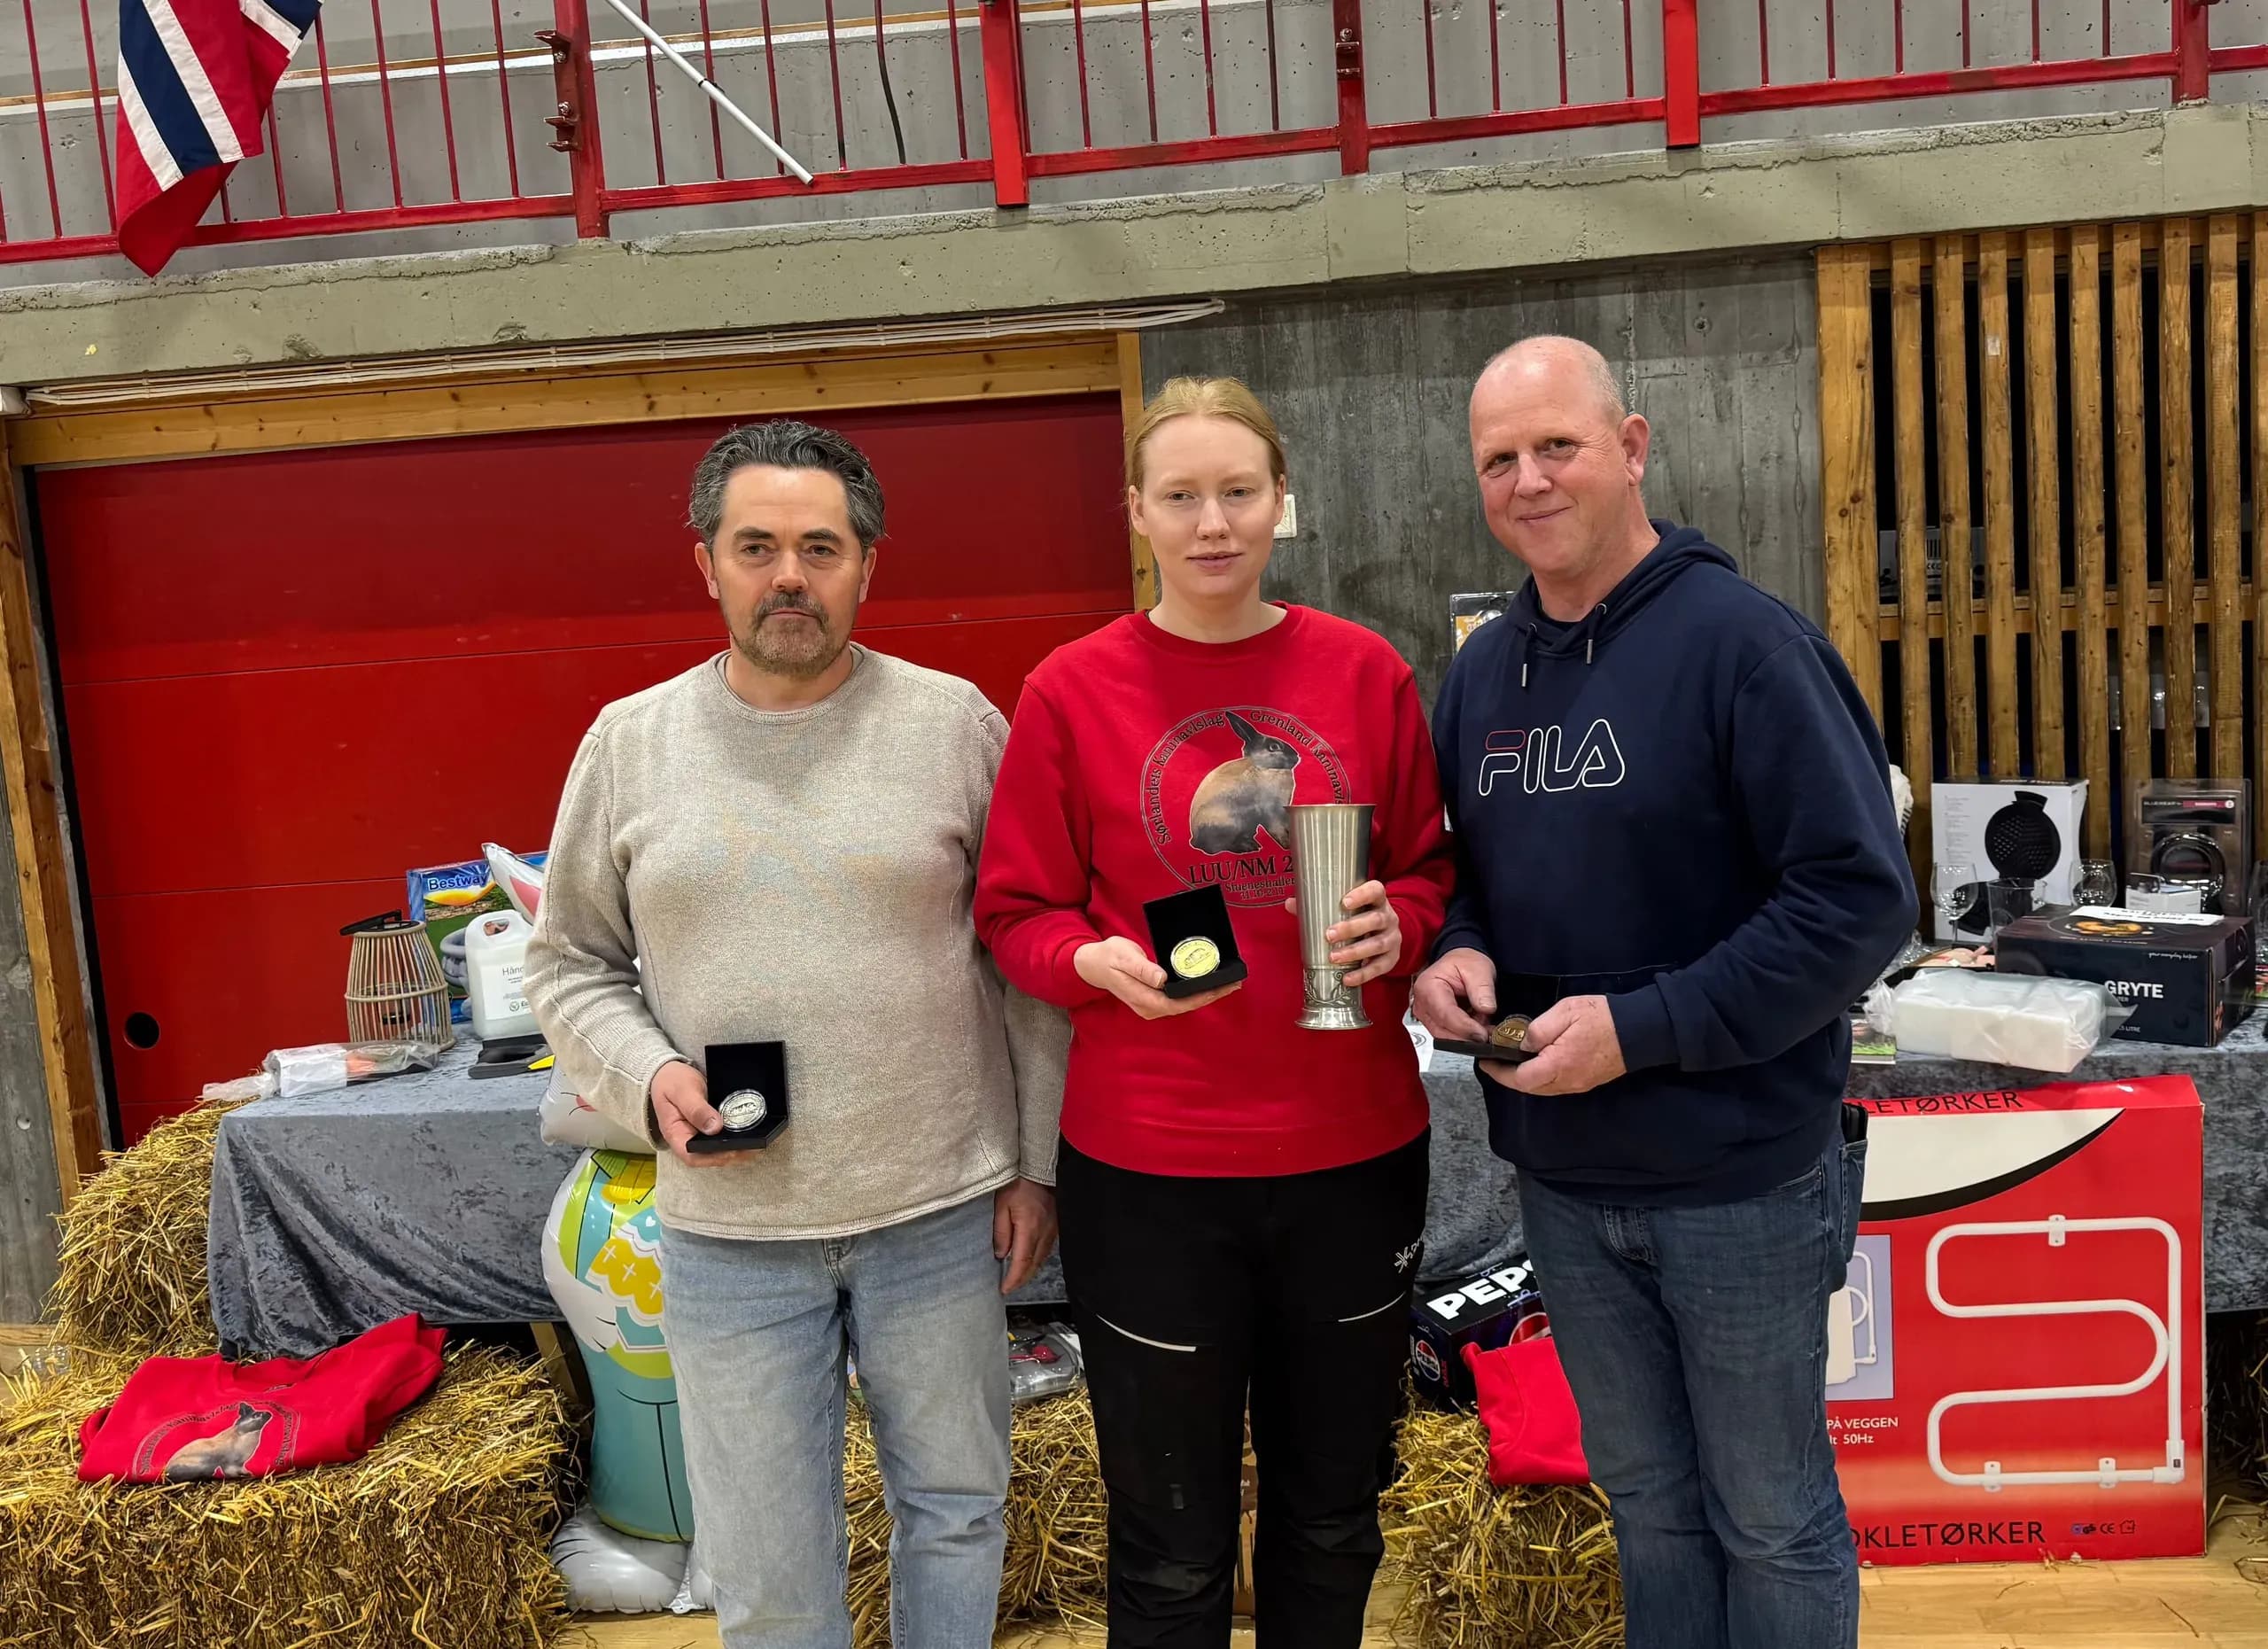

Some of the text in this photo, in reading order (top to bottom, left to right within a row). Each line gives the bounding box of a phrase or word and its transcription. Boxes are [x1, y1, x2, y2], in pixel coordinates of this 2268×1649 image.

[1153, 712, 1225, 766] Kaninavlslag
[1250, 711, 1315, 746] Grenland
[1478, 719, 1626, 797] FILA
[1189, 856, 1276, 884] LUU/NM
[427, 875, 487, 891] Bestway
[2104, 980, 2164, 999] GRYTE
[1826, 1416, 1899, 1430] PÅ VEGGEN
[1843, 1433, 1875, 1444] 50Hz
